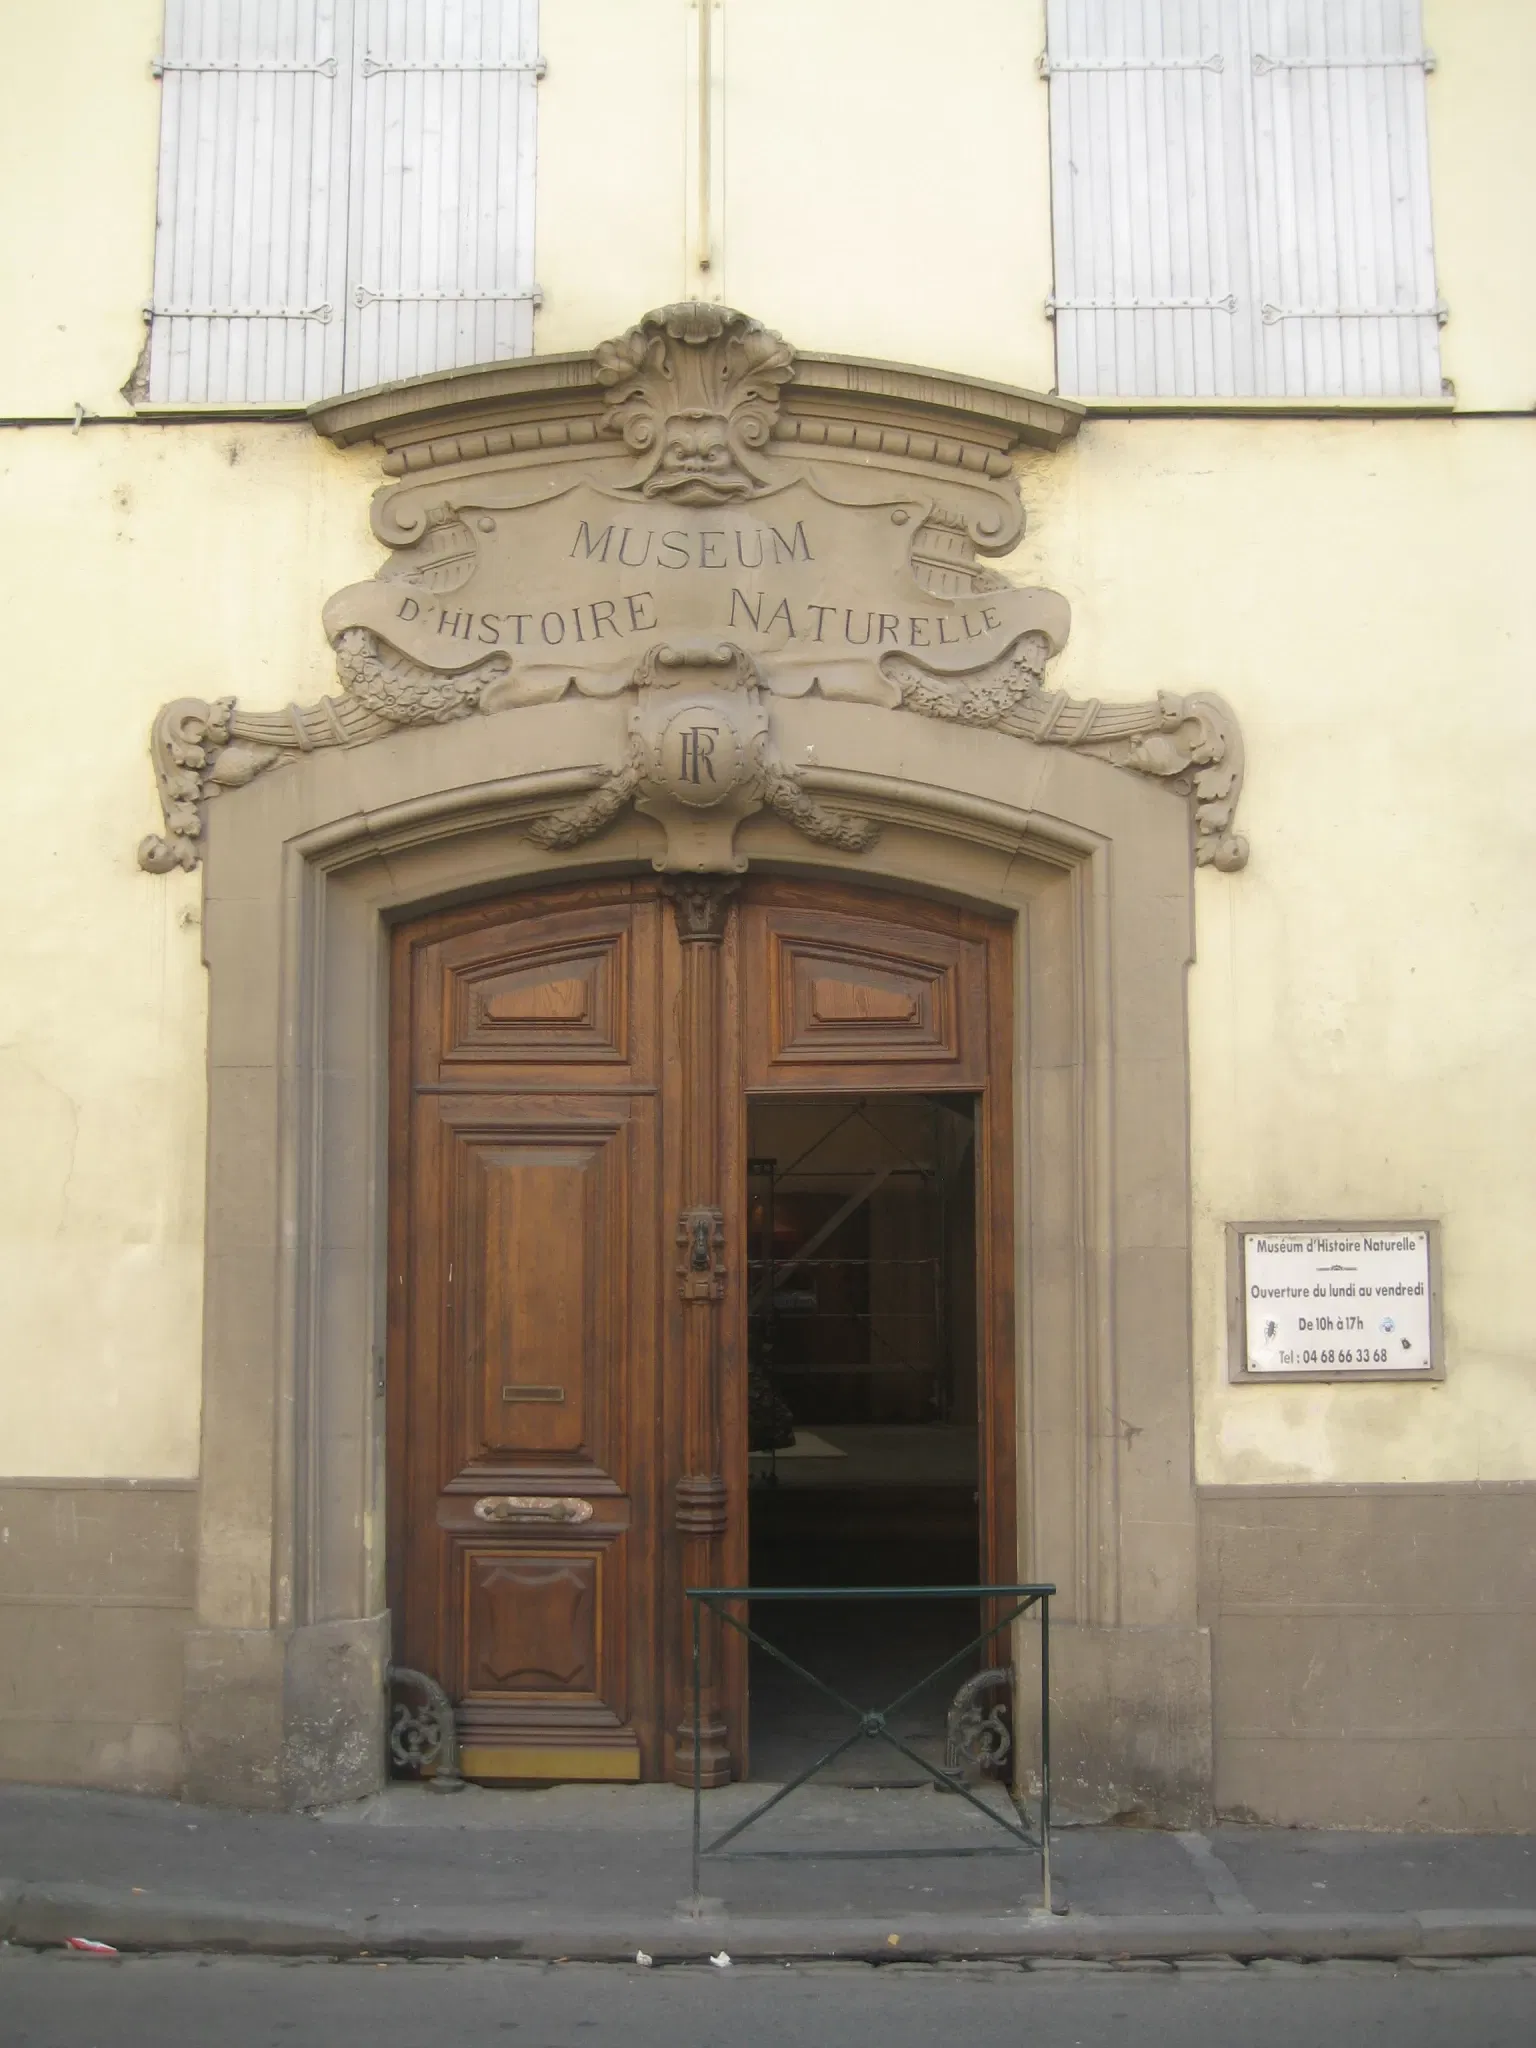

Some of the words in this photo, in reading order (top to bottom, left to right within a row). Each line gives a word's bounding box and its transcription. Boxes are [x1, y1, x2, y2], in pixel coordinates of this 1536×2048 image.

[568, 519, 816, 570] MUSEUM
[396, 591, 658, 645] D'HISTOIRE
[727, 588, 1002, 647] NATURELLE
[1257, 1239, 1303, 1254] Muséum
[1306, 1238, 1361, 1253] d'Histoire
[1363, 1237, 1416, 1252] Naturelle
[1251, 1285, 1310, 1299] Ouverture
[1313, 1284, 1327, 1298] du
[1329, 1283, 1356, 1297] lundi
[1358, 1286, 1373, 1297] au
[1375, 1282, 1424, 1296] vendredi
[1299, 1317, 1313, 1331] De
[1315, 1317, 1334, 1331] 10h
[1336, 1316, 1344, 1330] à
[1345, 1316, 1364, 1330] 17h
[1302, 1350, 1318, 1363] 04
[1320, 1350, 1335, 1363] 68
[1338, 1350, 1353, 1363] 66
[1356, 1349, 1370, 1363] 33
[1373, 1348, 1388, 1362] 68
